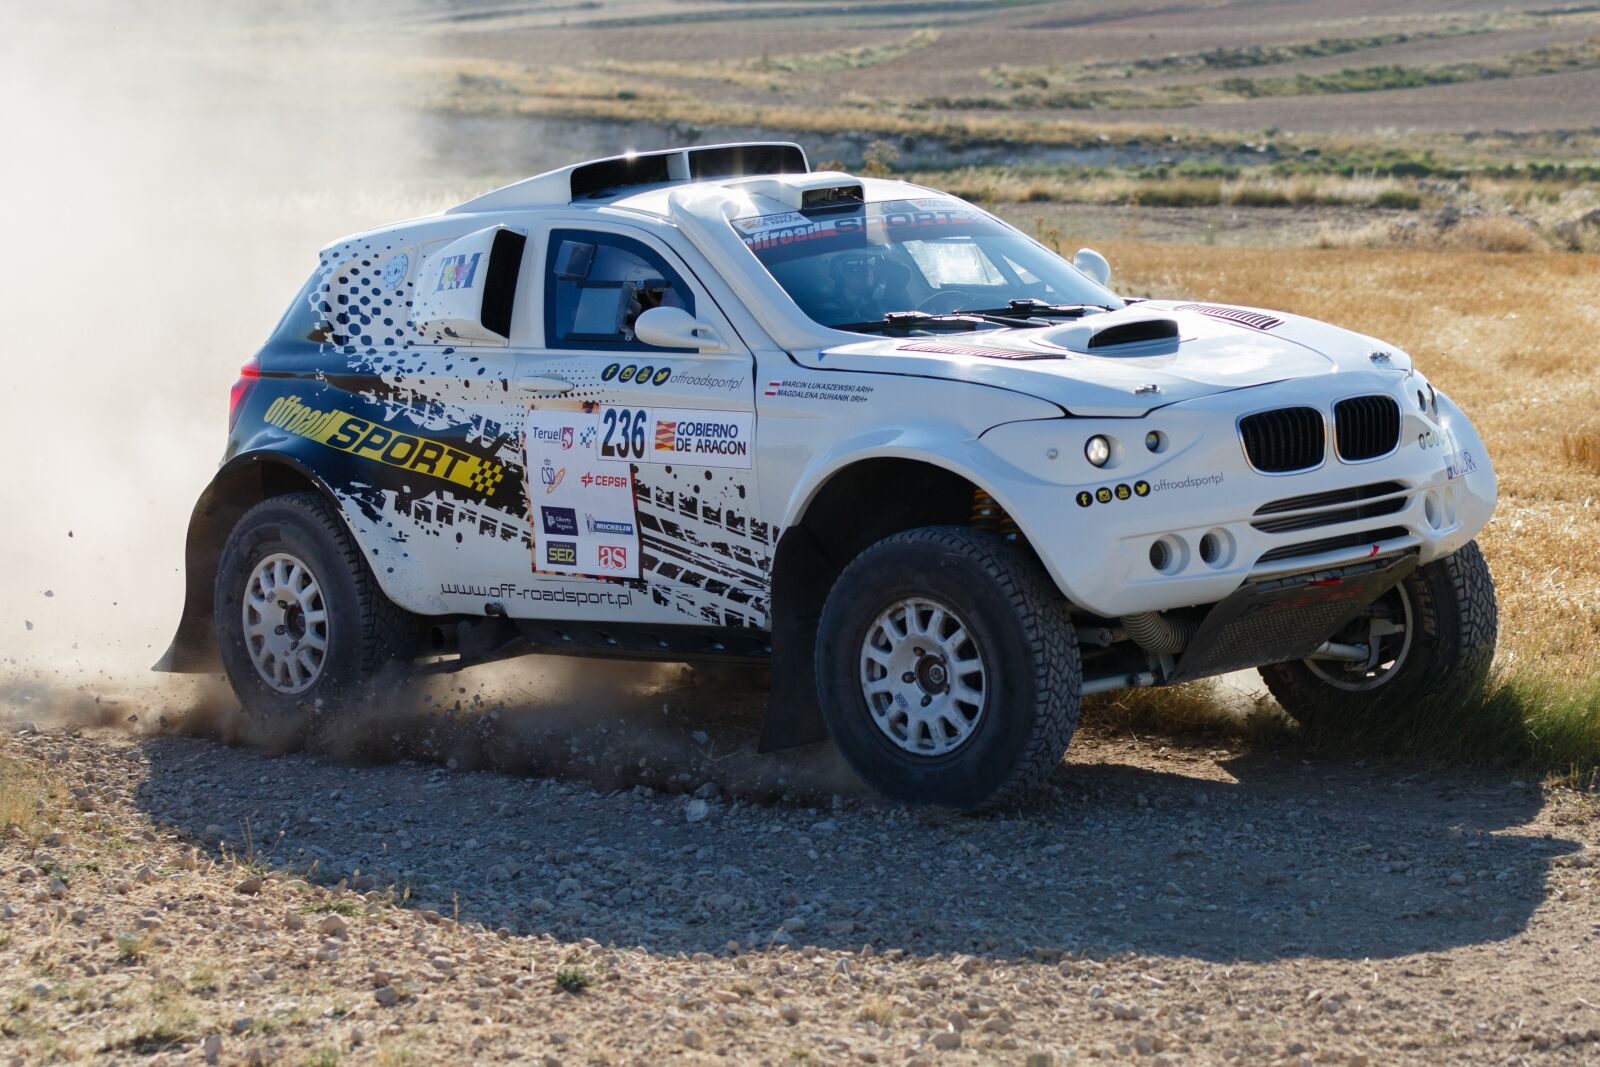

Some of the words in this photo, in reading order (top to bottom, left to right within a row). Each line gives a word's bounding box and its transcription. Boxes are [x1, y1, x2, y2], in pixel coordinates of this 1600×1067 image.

[670, 371, 745, 391] offroadsportpl
[780, 380, 807, 389] MARCIN
[776, 389, 818, 399] MAGDALENA
[819, 392, 850, 401] DUHANIK
[263, 395, 340, 439] offroad
[326, 418, 471, 480] SPORT
[533, 427, 562, 440] Teruel
[601, 408, 647, 459] 236
[677, 421, 739, 439] GOBIERNO
[676, 438, 692, 452] DE
[695, 439, 747, 456] ARAGON
[541, 467, 556, 485] CSD
[595, 475, 627, 488] CEPSA
[1153, 472, 1225, 492] offroadsportpl
[596, 522, 632, 533] MICHELIN
[600, 546, 625, 570] as
[440, 583, 633, 609] www.off-roadsport.pl
